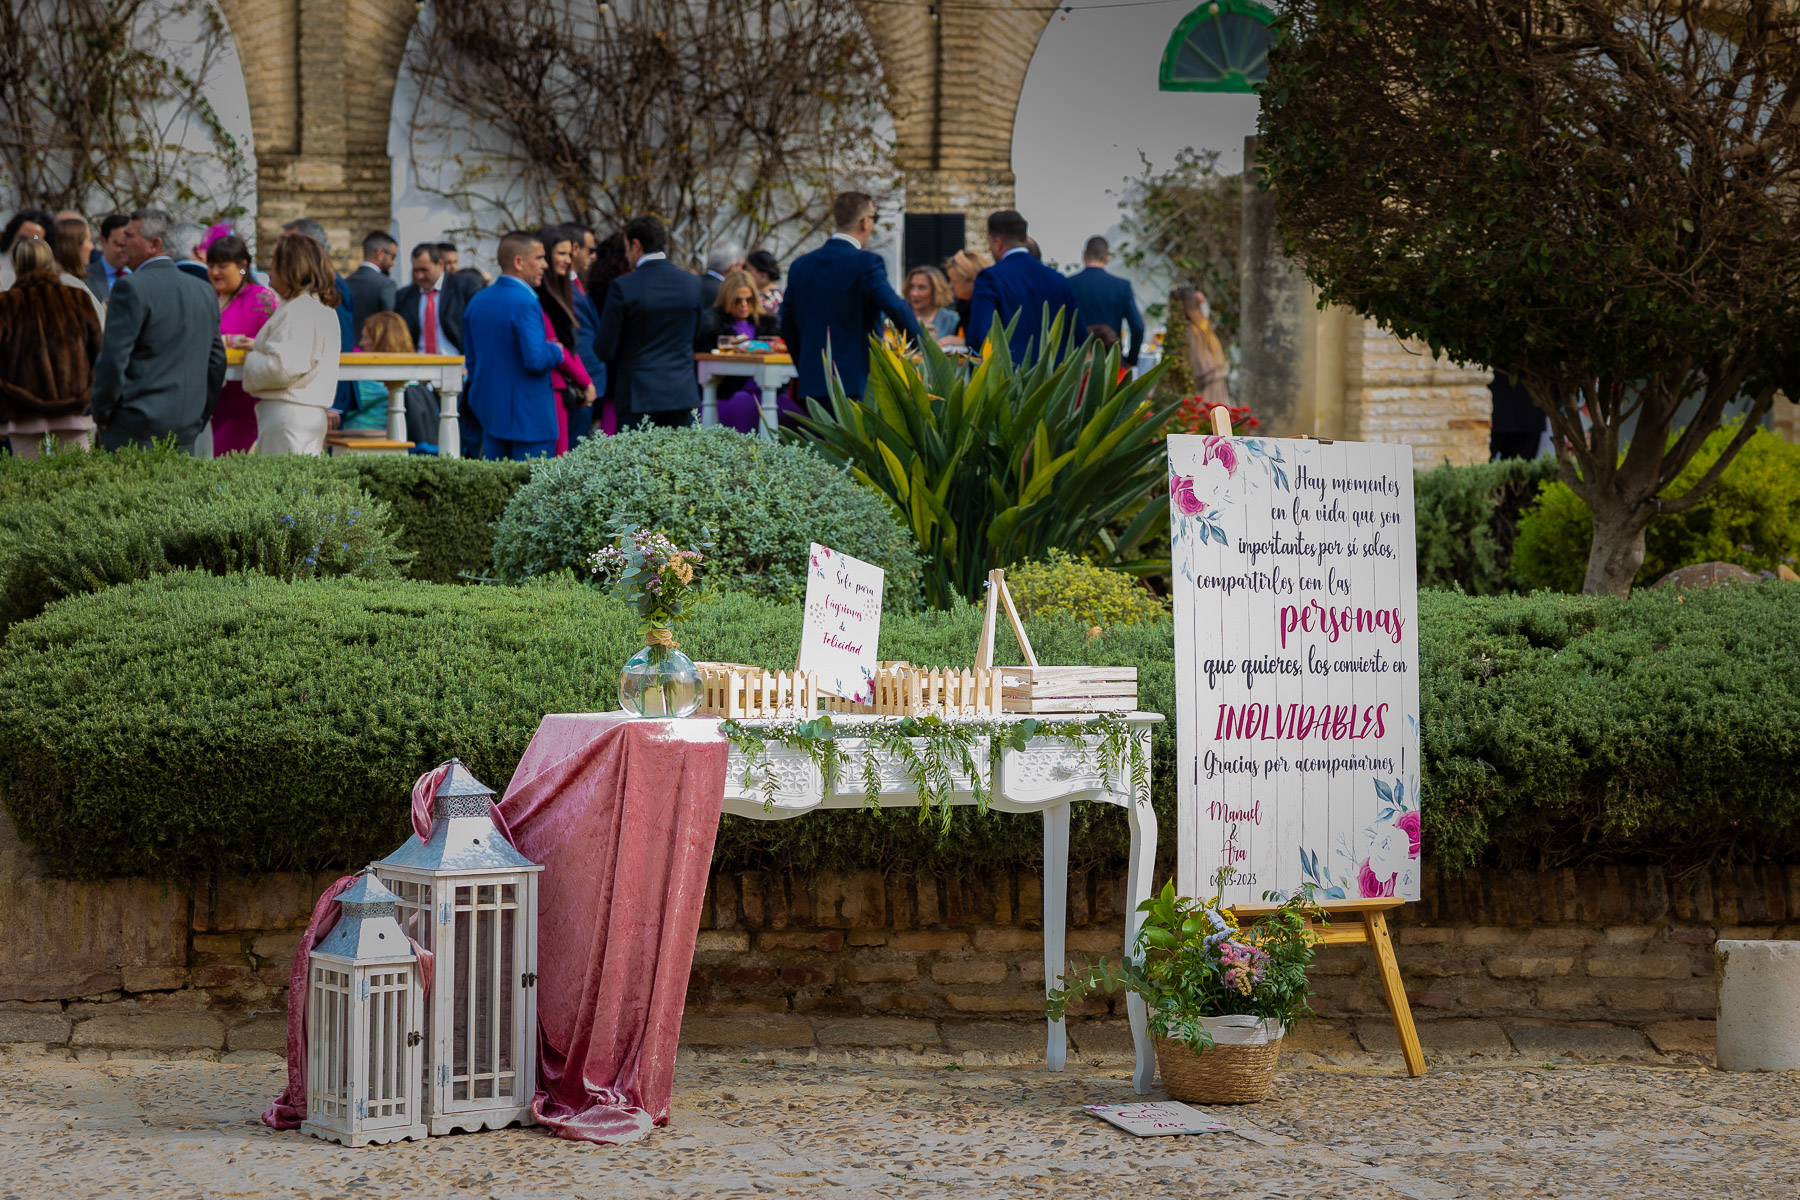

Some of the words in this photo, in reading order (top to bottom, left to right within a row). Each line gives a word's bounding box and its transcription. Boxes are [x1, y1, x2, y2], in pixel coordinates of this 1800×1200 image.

[1295, 465, 1327, 501] Hay
[1332, 474, 1400, 497] momentos
[1271, 507, 1287, 521] en
[1292, 496, 1311, 526] la
[1316, 498, 1347, 523] vida
[1352, 511, 1376, 527] que
[1380, 511, 1401, 528] son
[1238, 531, 1317, 566] importantes
[1318, 540, 1343, 566] por
[1347, 538, 1358, 557] sí
[1363, 531, 1396, 560] solos,
[856, 583, 874, 597] para
[1197, 565, 1294, 596] compartirlos
[1300, 577, 1323, 591] con
[1328, 567, 1351, 596] las
[838, 621, 846, 632] de
[1280, 599, 1405, 649] personas
[823, 632, 863, 656] Felicidad
[1203, 657, 1236, 690] que
[1241, 655, 1303, 690] quieres,
[1308, 644, 1332, 676] los
[1333, 649, 1389, 674] convierte
[1392, 660, 1408, 673] en
[1214, 702, 1389, 741] INOLVIDABLES
[1264, 756, 1290, 780] por
[1206, 799, 1263, 826] Manuel
[1229, 823, 1239, 842] &
[1220, 839, 1248, 866] Ara
[1210, 872, 1257, 887] 0403-2023
